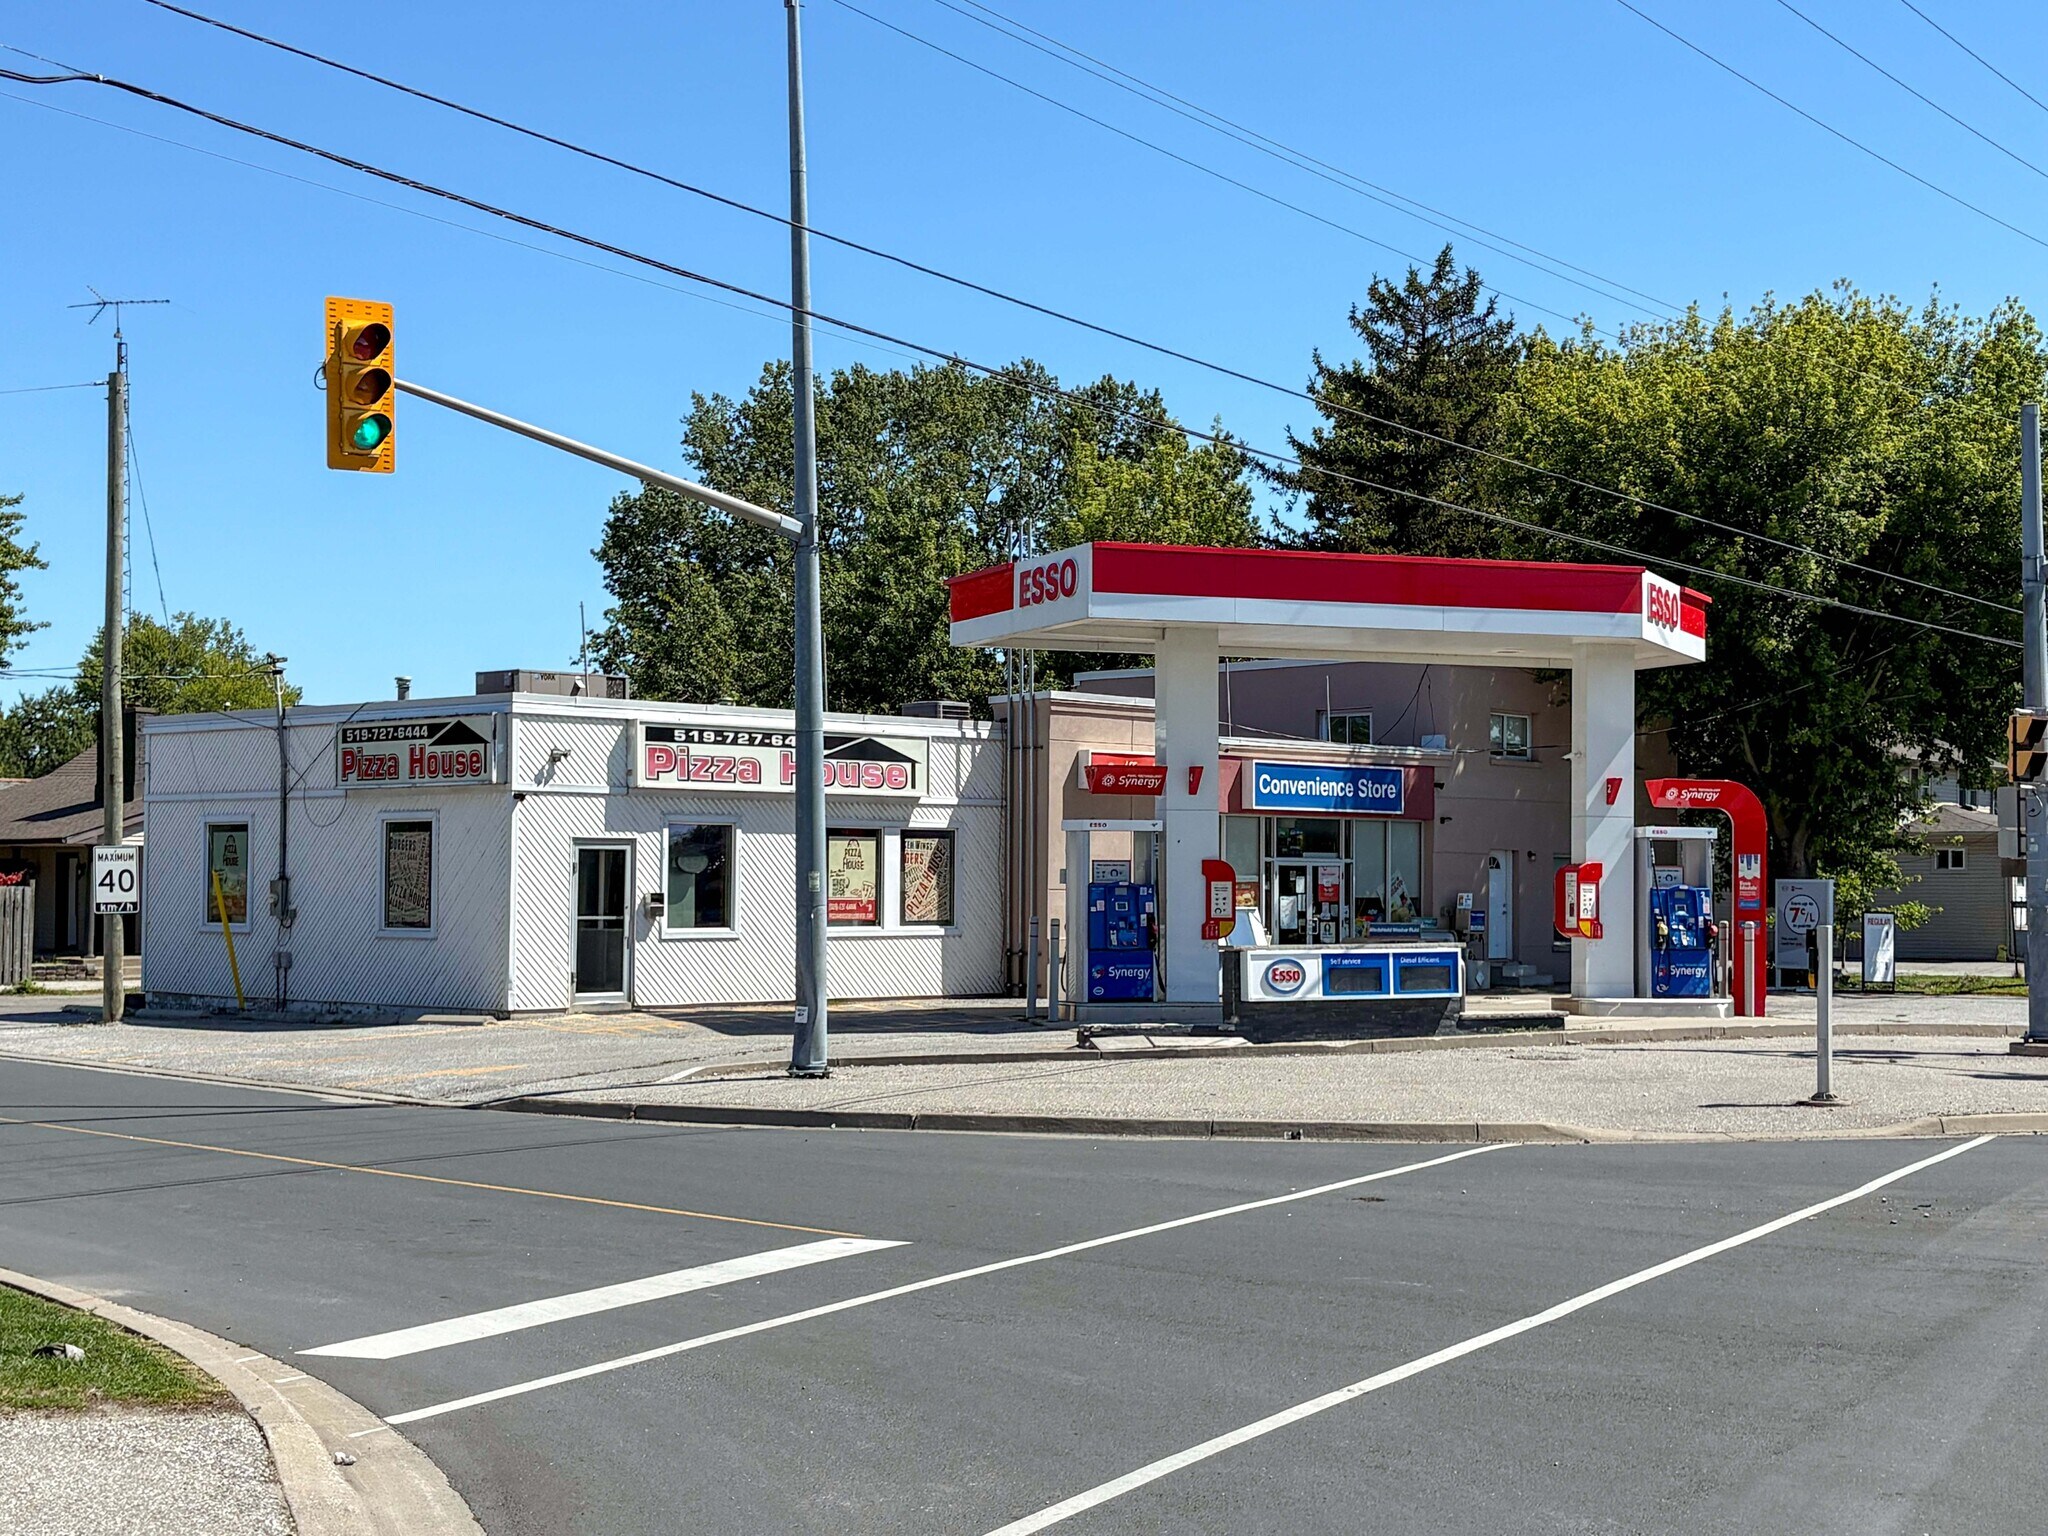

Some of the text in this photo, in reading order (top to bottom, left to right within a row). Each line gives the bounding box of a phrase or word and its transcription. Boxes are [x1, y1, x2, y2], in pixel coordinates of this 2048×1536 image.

[1019, 559, 1078, 608] ESSO
[1648, 583, 1679, 630] ESSO
[346, 725, 429, 742] 519-727-6444
[673, 729, 797, 747] 519-727-64
[341, 744, 483, 781] Pizza House
[644, 744, 761, 784] Pizza
[1118, 775, 1162, 788] Synergy
[1259, 774, 1397, 798] Convenience Store
[1680, 789, 1720, 801] Synergy
[97, 852, 135, 862] MAXIMUM
[844, 847, 863, 859] PIZZA
[842, 858, 865, 871] HOUSE
[97, 868, 135, 893] 40
[905, 882, 929, 916] PIZZA
[922, 845, 948, 884] HOUSE
[100, 902, 134, 912] km/h
[1108, 966, 1151, 980] Synergy
[1271, 967, 1301, 983] Esso
[1670, 964, 1707, 978] Synergy
